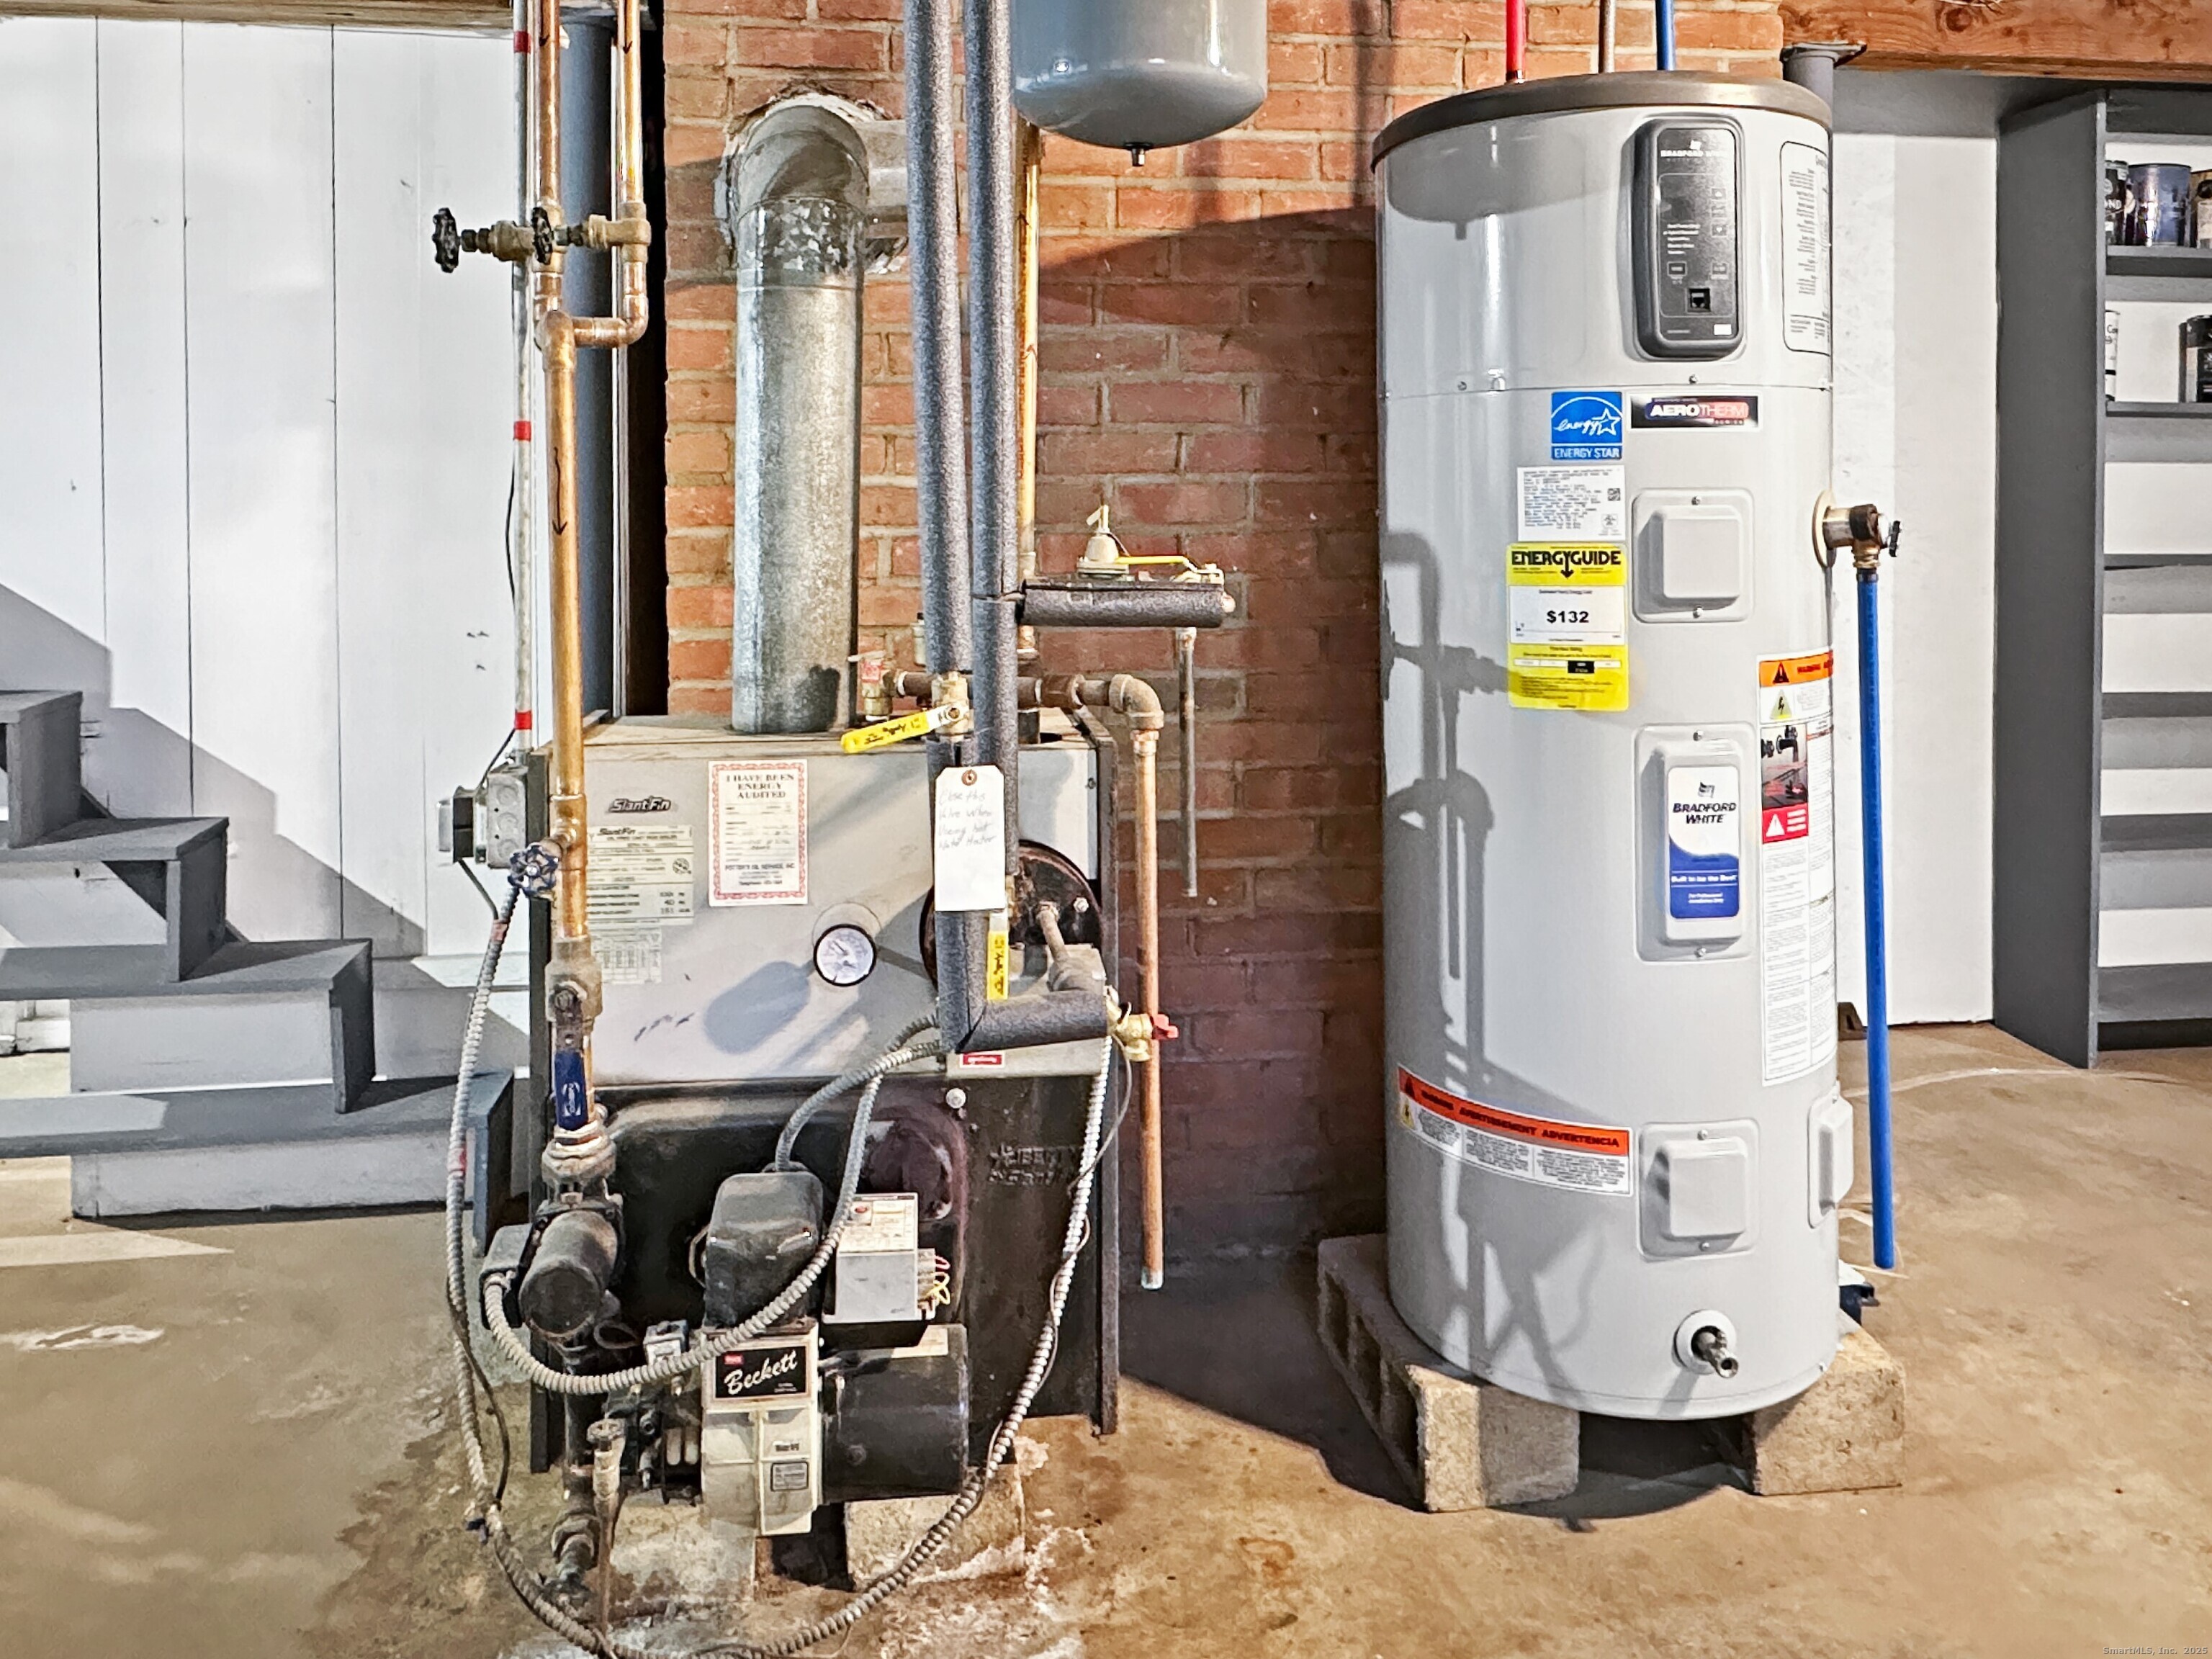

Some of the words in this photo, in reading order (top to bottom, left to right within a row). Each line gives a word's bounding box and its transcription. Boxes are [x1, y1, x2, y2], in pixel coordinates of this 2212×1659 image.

[1554, 447, 1592, 459] ENERGY
[1593, 447, 1619, 459] STAR
[1511, 550, 1622, 567] ENERGYGUIDE
[1547, 610, 1590, 624] $132
[737, 782, 781, 791] ENERGY
[1673, 802, 1737, 813] BRADFORD
[1686, 814, 1725, 824] WHITE
[1541, 1129, 1620, 1148] ADVERTENCIA
[724, 1349, 798, 1395] Beckett
